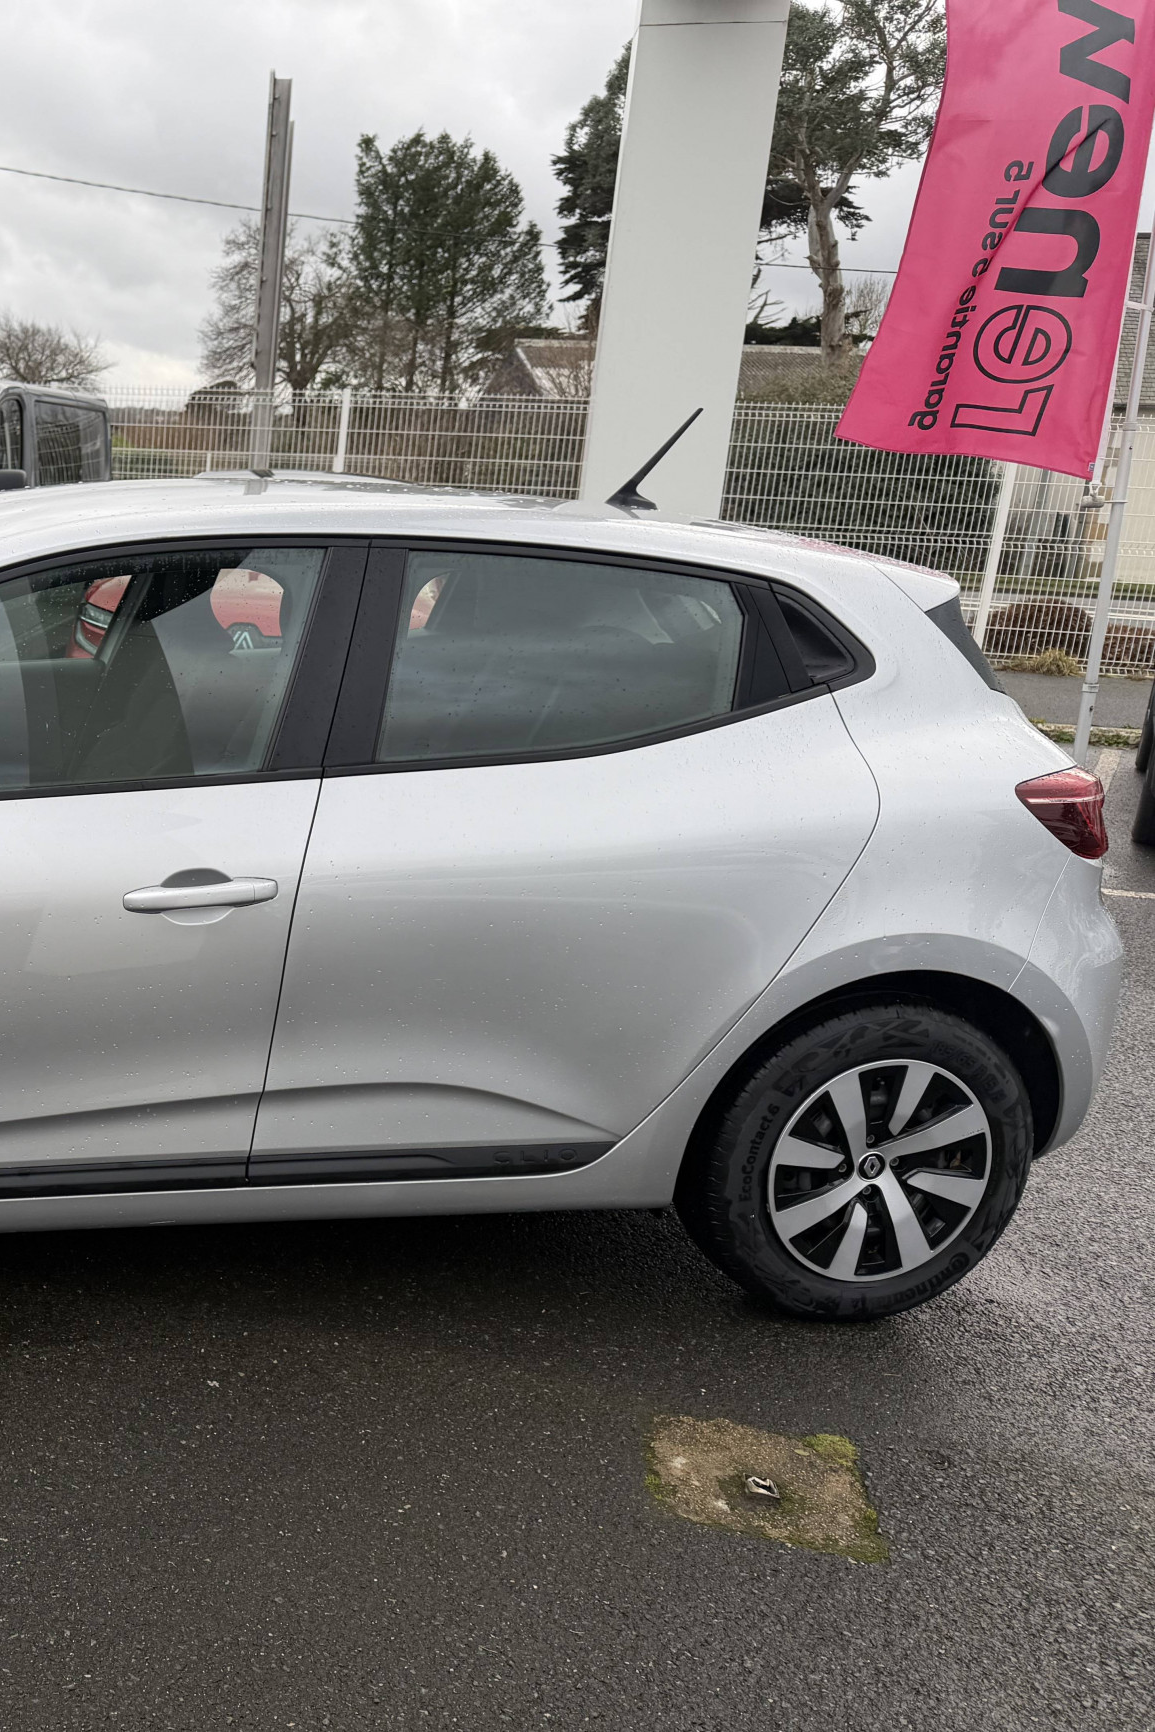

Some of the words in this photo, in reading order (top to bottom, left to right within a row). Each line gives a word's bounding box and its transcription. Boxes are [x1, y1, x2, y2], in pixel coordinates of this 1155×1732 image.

[492, 1147, 578, 1164] CLIO
[738, 1115, 774, 1202] EcoContact
[767, 1103, 781, 1115] 6
